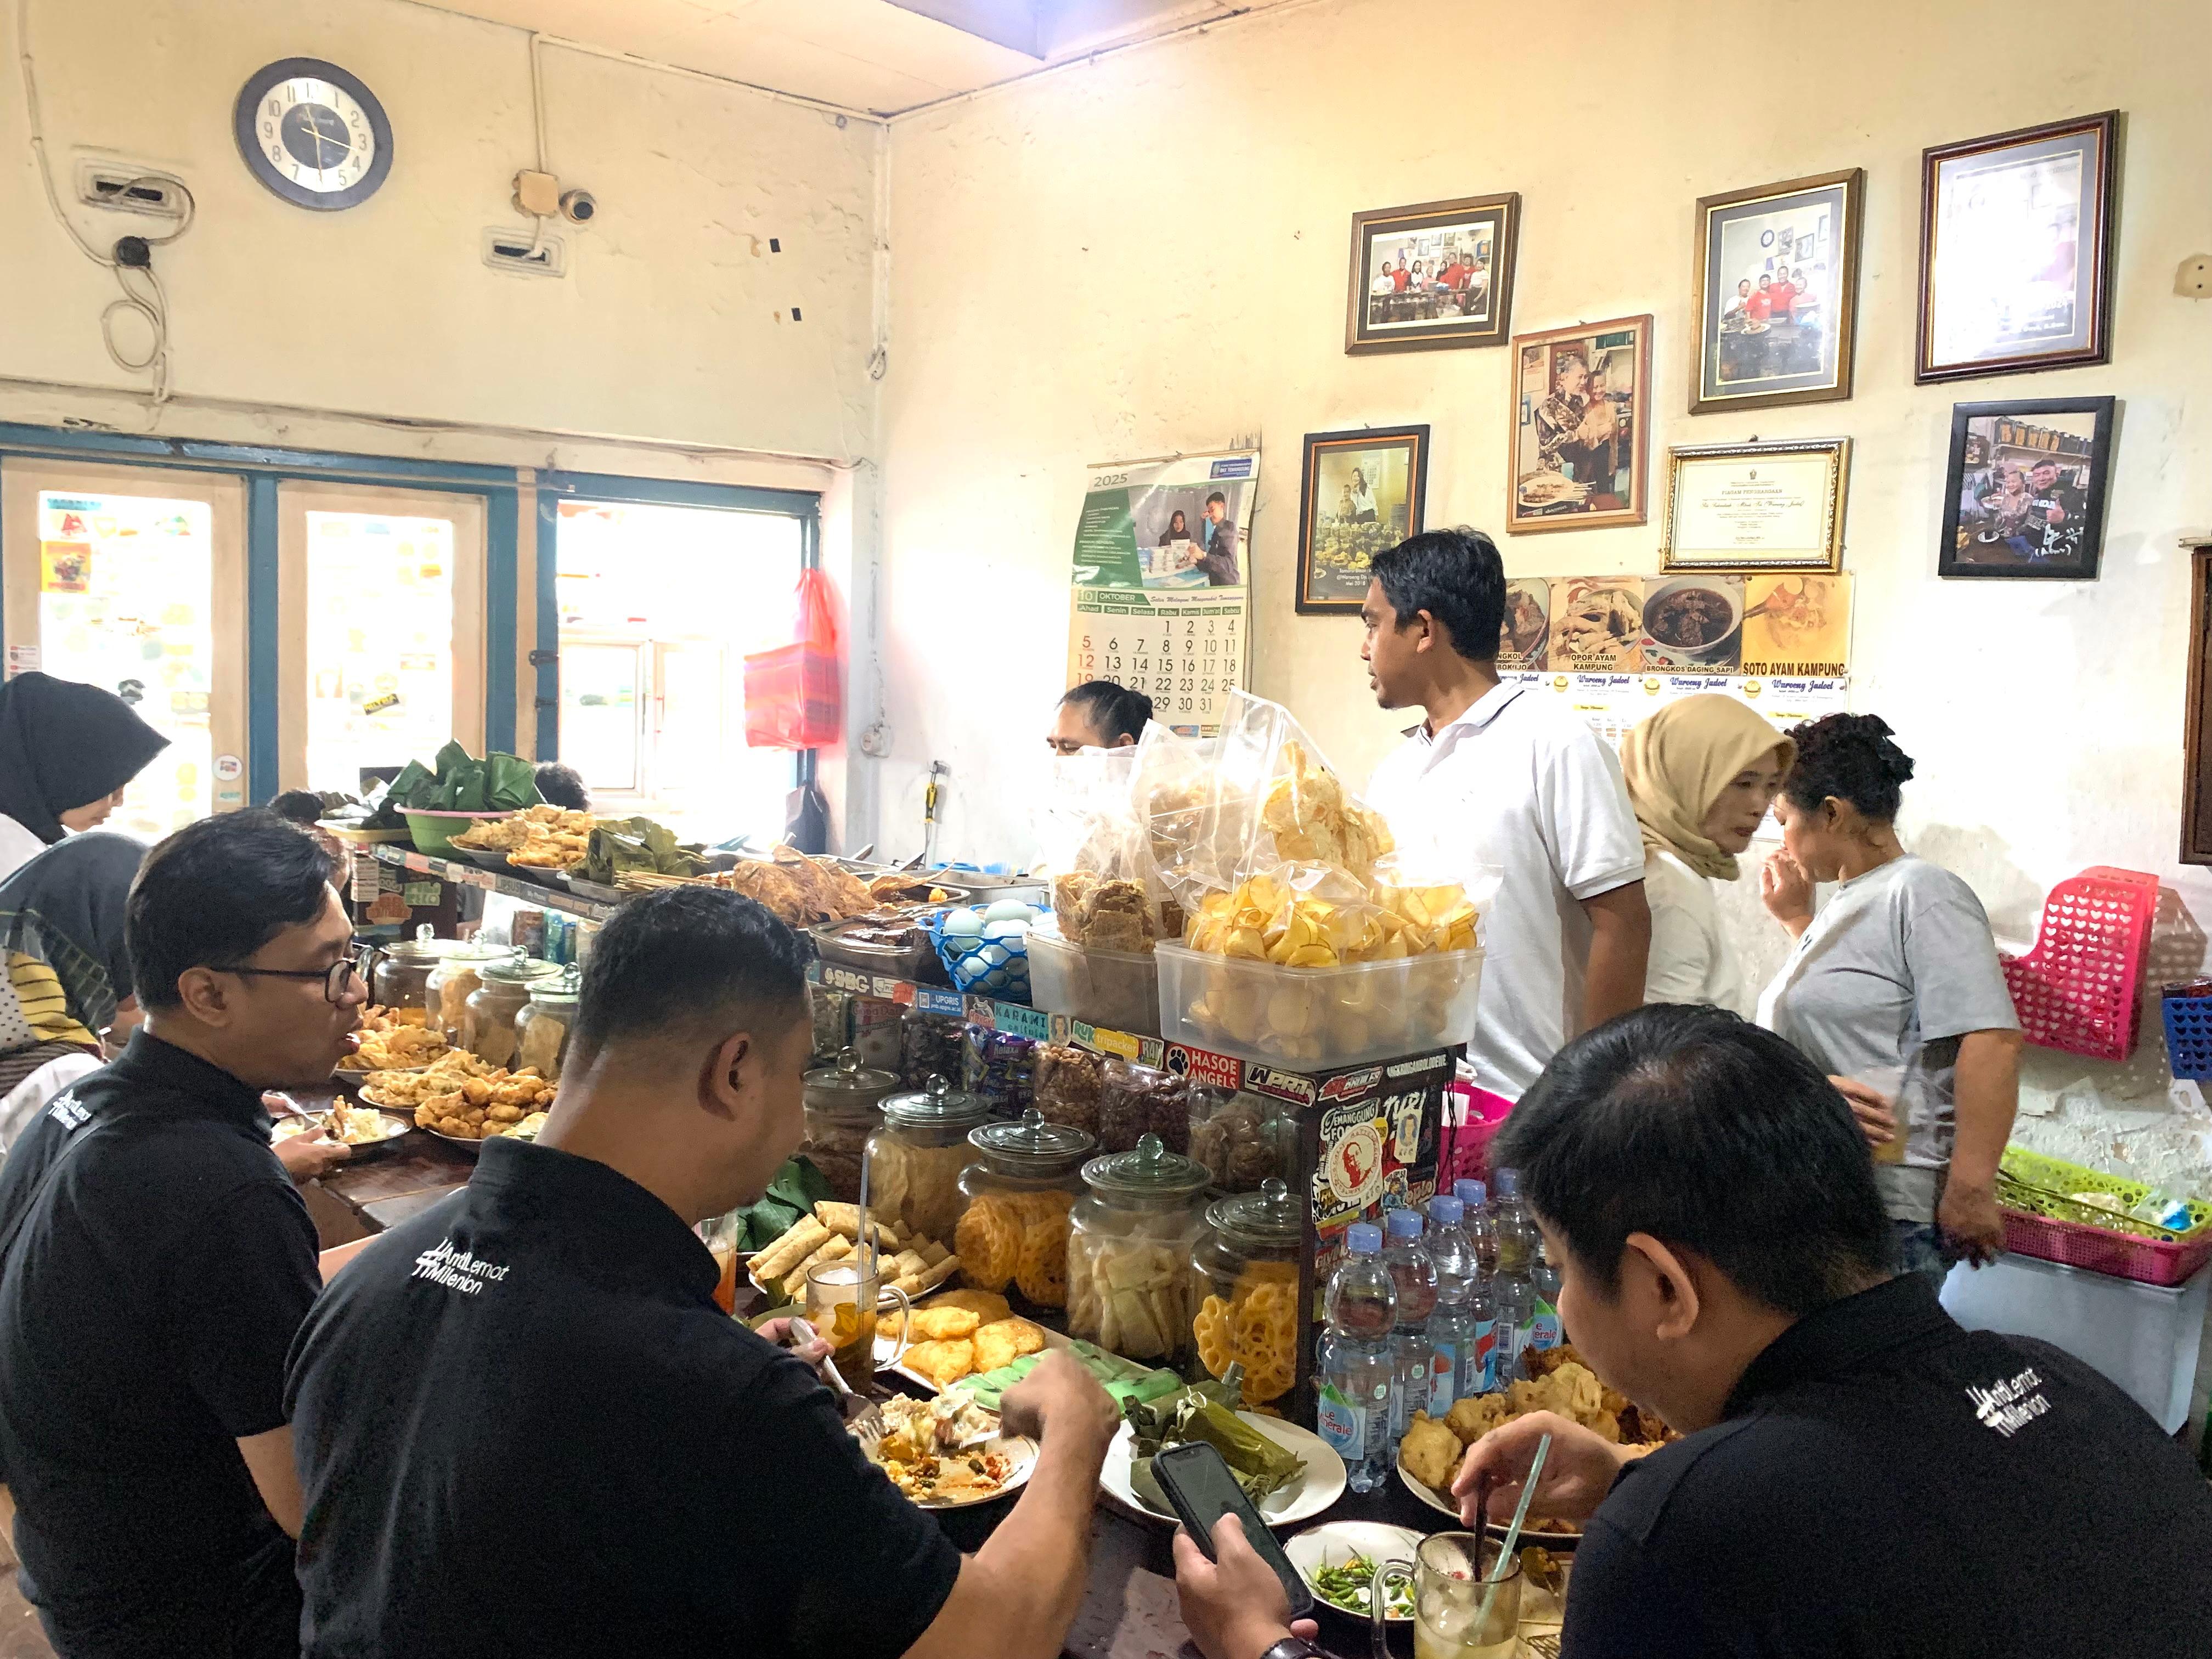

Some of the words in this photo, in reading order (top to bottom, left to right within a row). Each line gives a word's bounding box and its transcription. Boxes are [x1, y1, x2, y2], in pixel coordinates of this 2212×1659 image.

[287, 85, 296, 102] 11
[335, 91, 338, 109] 1
[268, 99, 281, 117] 10
[351, 111, 359, 128] 2
[264, 121, 273, 139] 9
[358, 133, 367, 151] 3
[273, 145, 281, 162] 8
[292, 163, 299, 180] 7
[352, 155, 360, 172] 4
[338, 169, 347, 185] 5
[1094, 473, 1128, 487] 2025
[1079, 590, 1092, 601] 10
[1099, 593, 1135, 601] OKTOBER
[1165, 620, 1170, 633] 1
[1187, 620, 1194, 633] 2
[1208, 620, 1214, 633] 3
[1228, 619, 1234, 631] 4
[1082, 636, 1091, 648] 5
[1109, 637, 1118, 650] 6
[1137, 639, 1144, 651] 7
[1163, 640, 1170, 652] 8
[1186, 640, 1193, 652] 9
[1205, 640, 1217, 652] 10
[1225, 639, 1235, 652] 11
[1079, 654, 1094, 667] 12
[1105, 656, 1121, 669] 13
[1133, 658, 1148, 670] 14
[1159, 659, 1173, 671] 15
[1182, 659, 1195, 672] 16
[1203, 659, 1215, 672] 17
[1224, 659, 1235, 672] 18
[1743, 663, 1767, 675] SOTO
[1770, 663, 1794, 676] AYAM
[1797, 663, 1845, 676] KAMPUNG
[1077, 673, 1093, 685] 19
[1103, 675, 1120, 685] 20
[1130, 676, 1144, 689] 21
[1155, 678, 1171, 690] 22
[1180, 679, 1193, 691] 23
[1201, 679, 1214, 691] 24
[1222, 679, 1235, 691] 25
[1154, 697, 1170, 709] 29
[1178, 698, 1193, 710] 30
[1200, 698, 1211, 710] 31
[935, 994, 959, 1006] UPGRIS
[996, 1006, 1046, 1028] KARAMI
[994, 1044, 1019, 1055] Relaxa
[1097, 1034, 1137, 1052] tripacker
[1192, 1050, 1237, 1076] HASOE
[1189, 1068, 1237, 1089] ANGELS
[1324, 1103, 1375, 1135] TEMANGGUNG
[1324, 1406, 1335, 1420] Le
[1319, 1412, 1353, 1436] Minerale
